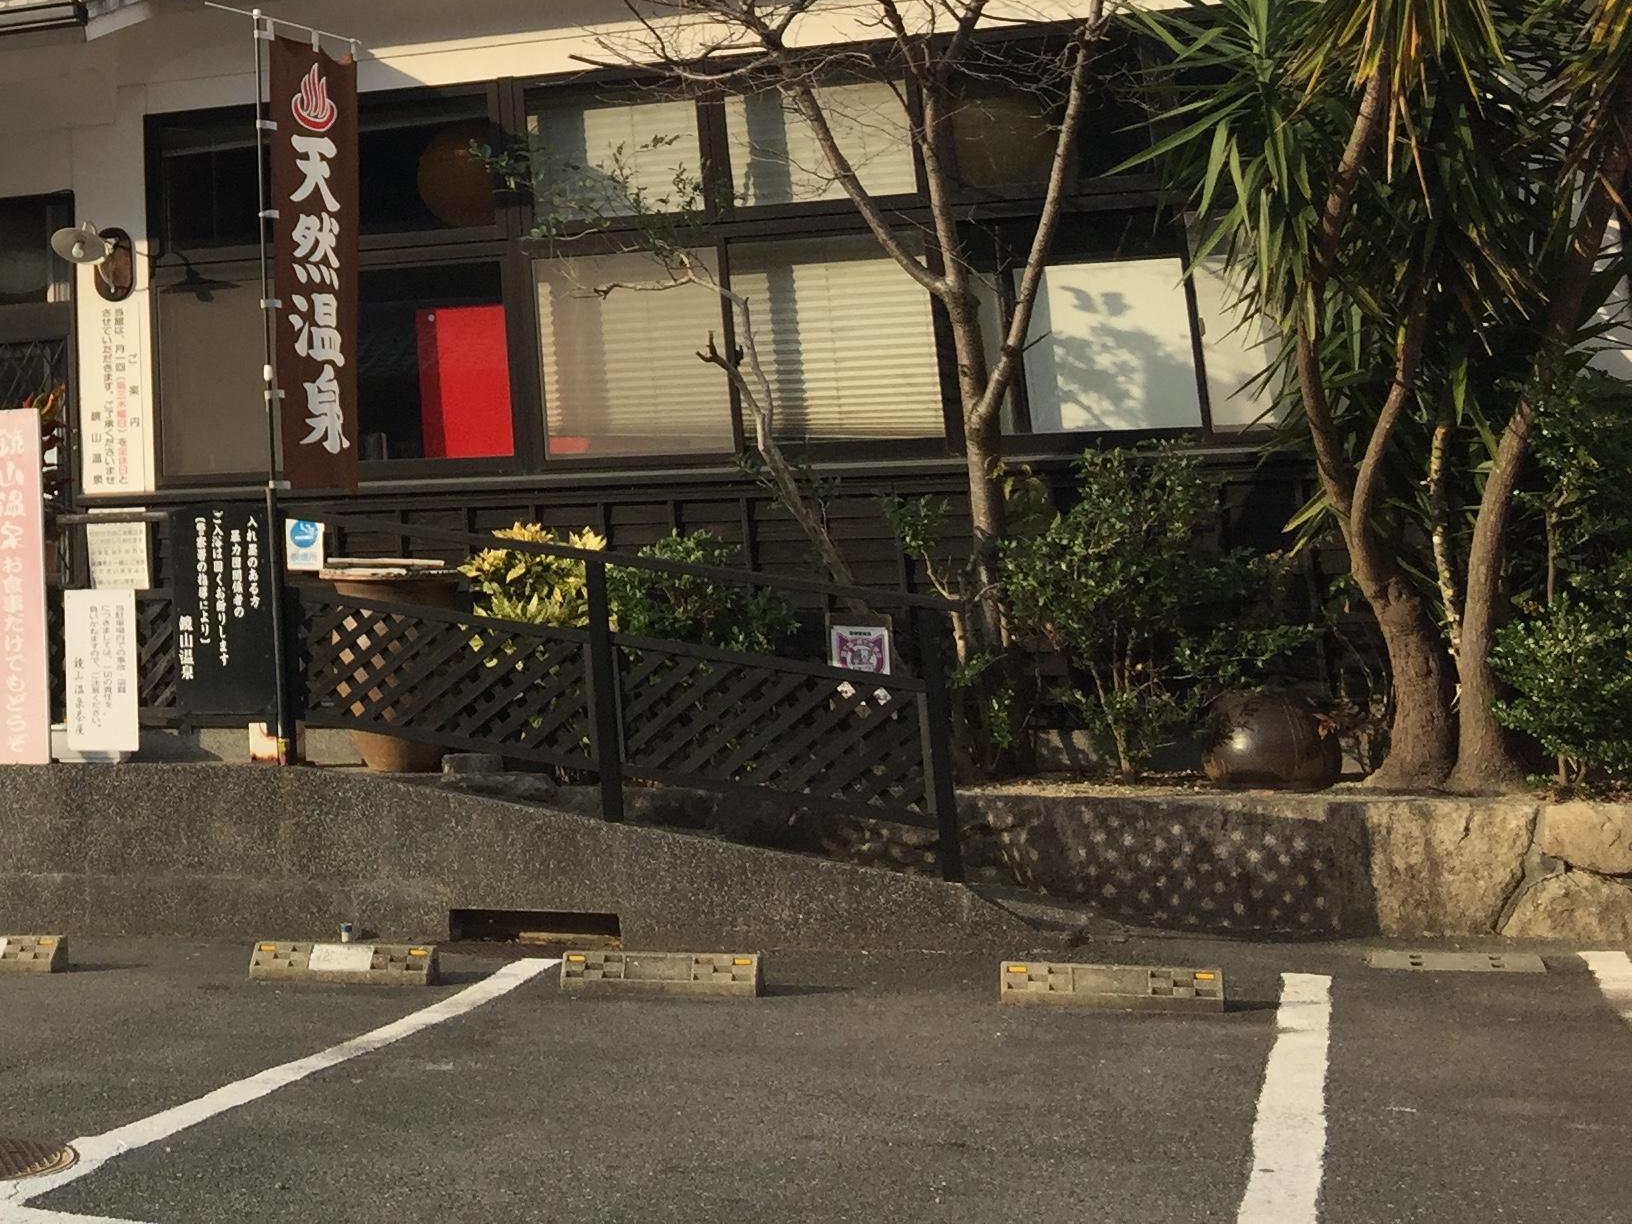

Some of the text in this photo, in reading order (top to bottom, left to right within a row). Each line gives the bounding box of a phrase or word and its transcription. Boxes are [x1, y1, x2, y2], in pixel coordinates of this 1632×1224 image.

[289, 135, 350, 454] 天然温泉
[246, 515, 260, 609] 入れ墨のある方
[179, 615, 194, 680] 鏡山温泉
